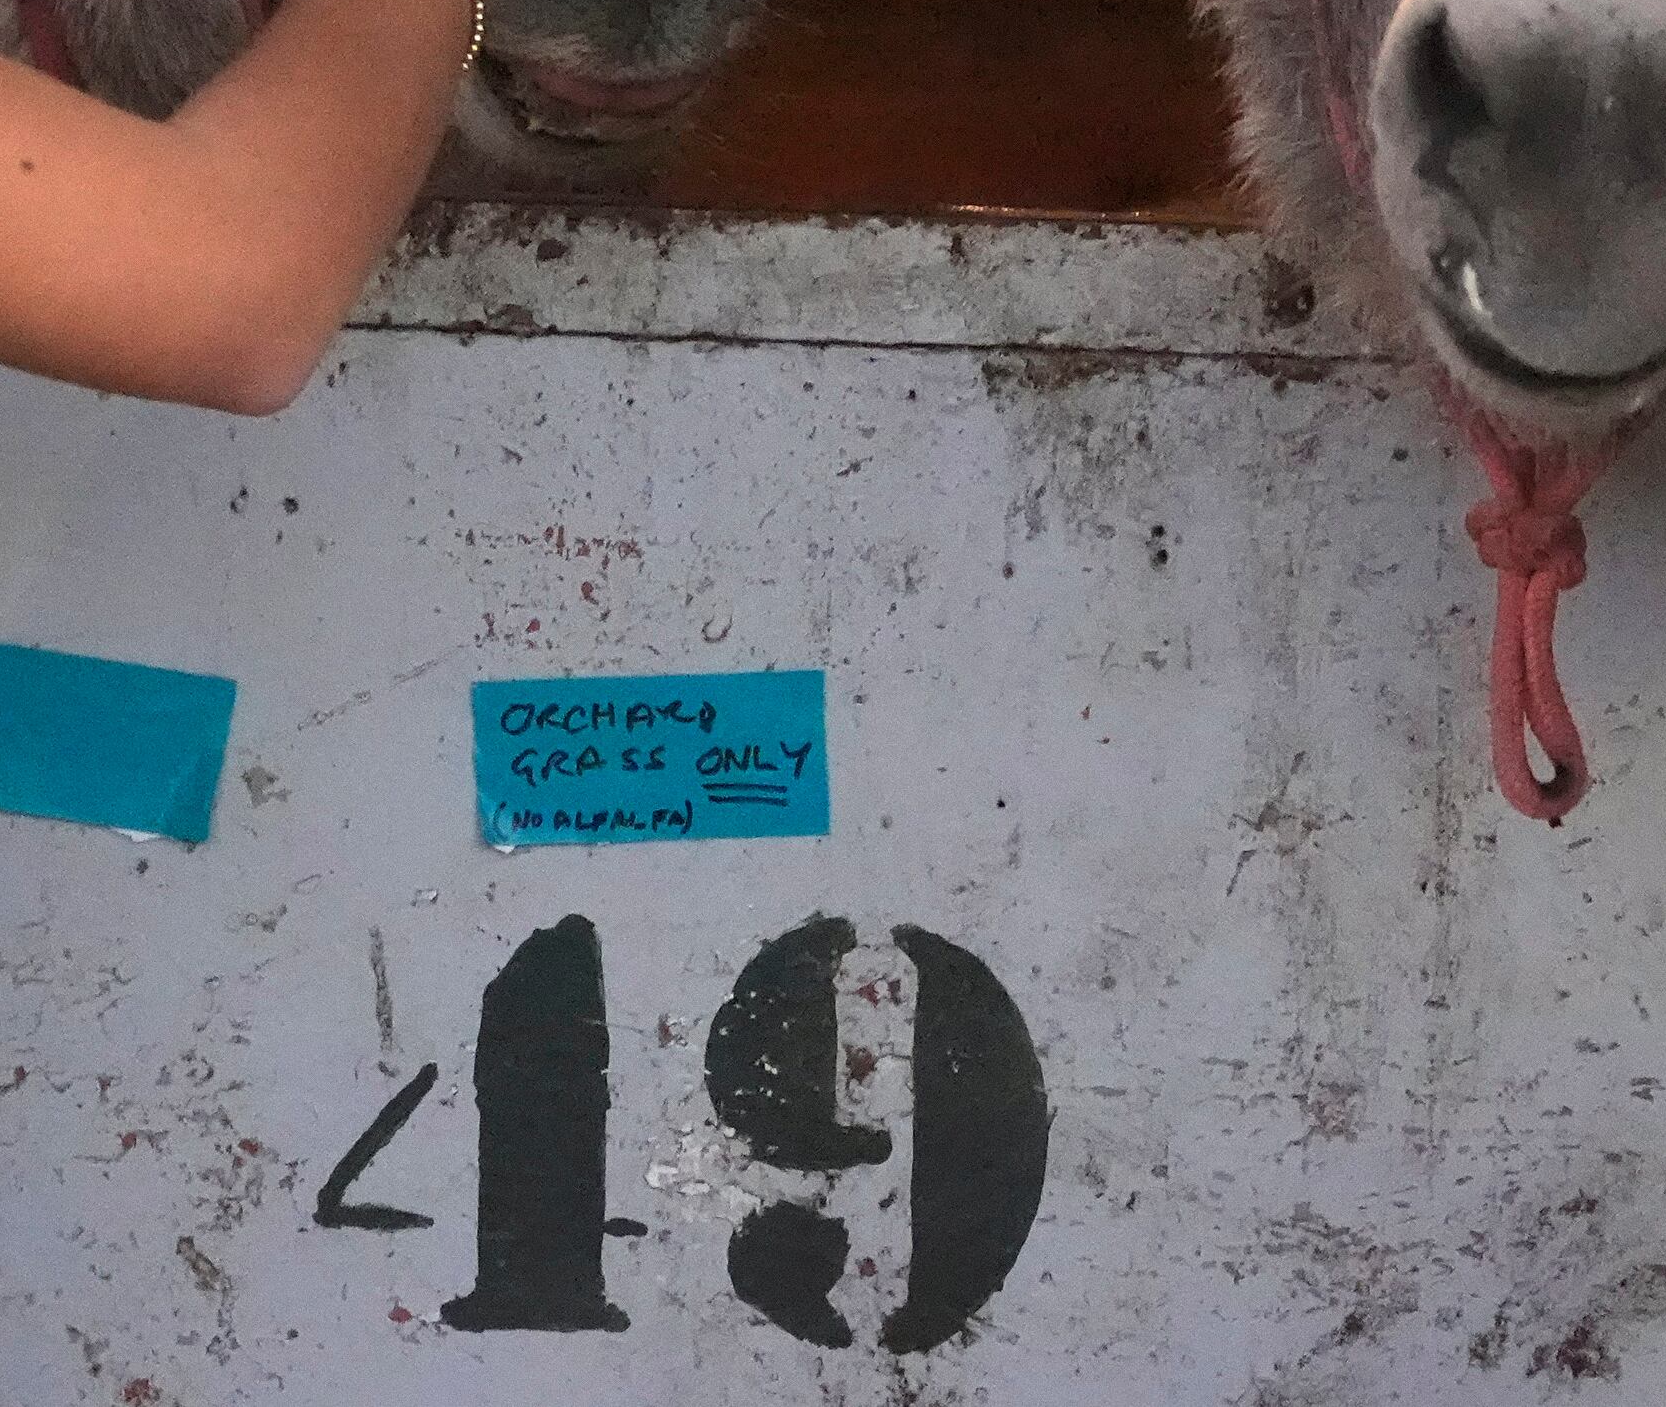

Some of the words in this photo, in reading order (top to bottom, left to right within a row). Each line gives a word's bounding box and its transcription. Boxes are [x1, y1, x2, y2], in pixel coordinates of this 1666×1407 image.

[500, 699, 718, 736] ORCHARD
[510, 744, 667, 787] GRASS
[695, 741, 813, 779] ONLY
[312, 912, 1051, 1354] 49
